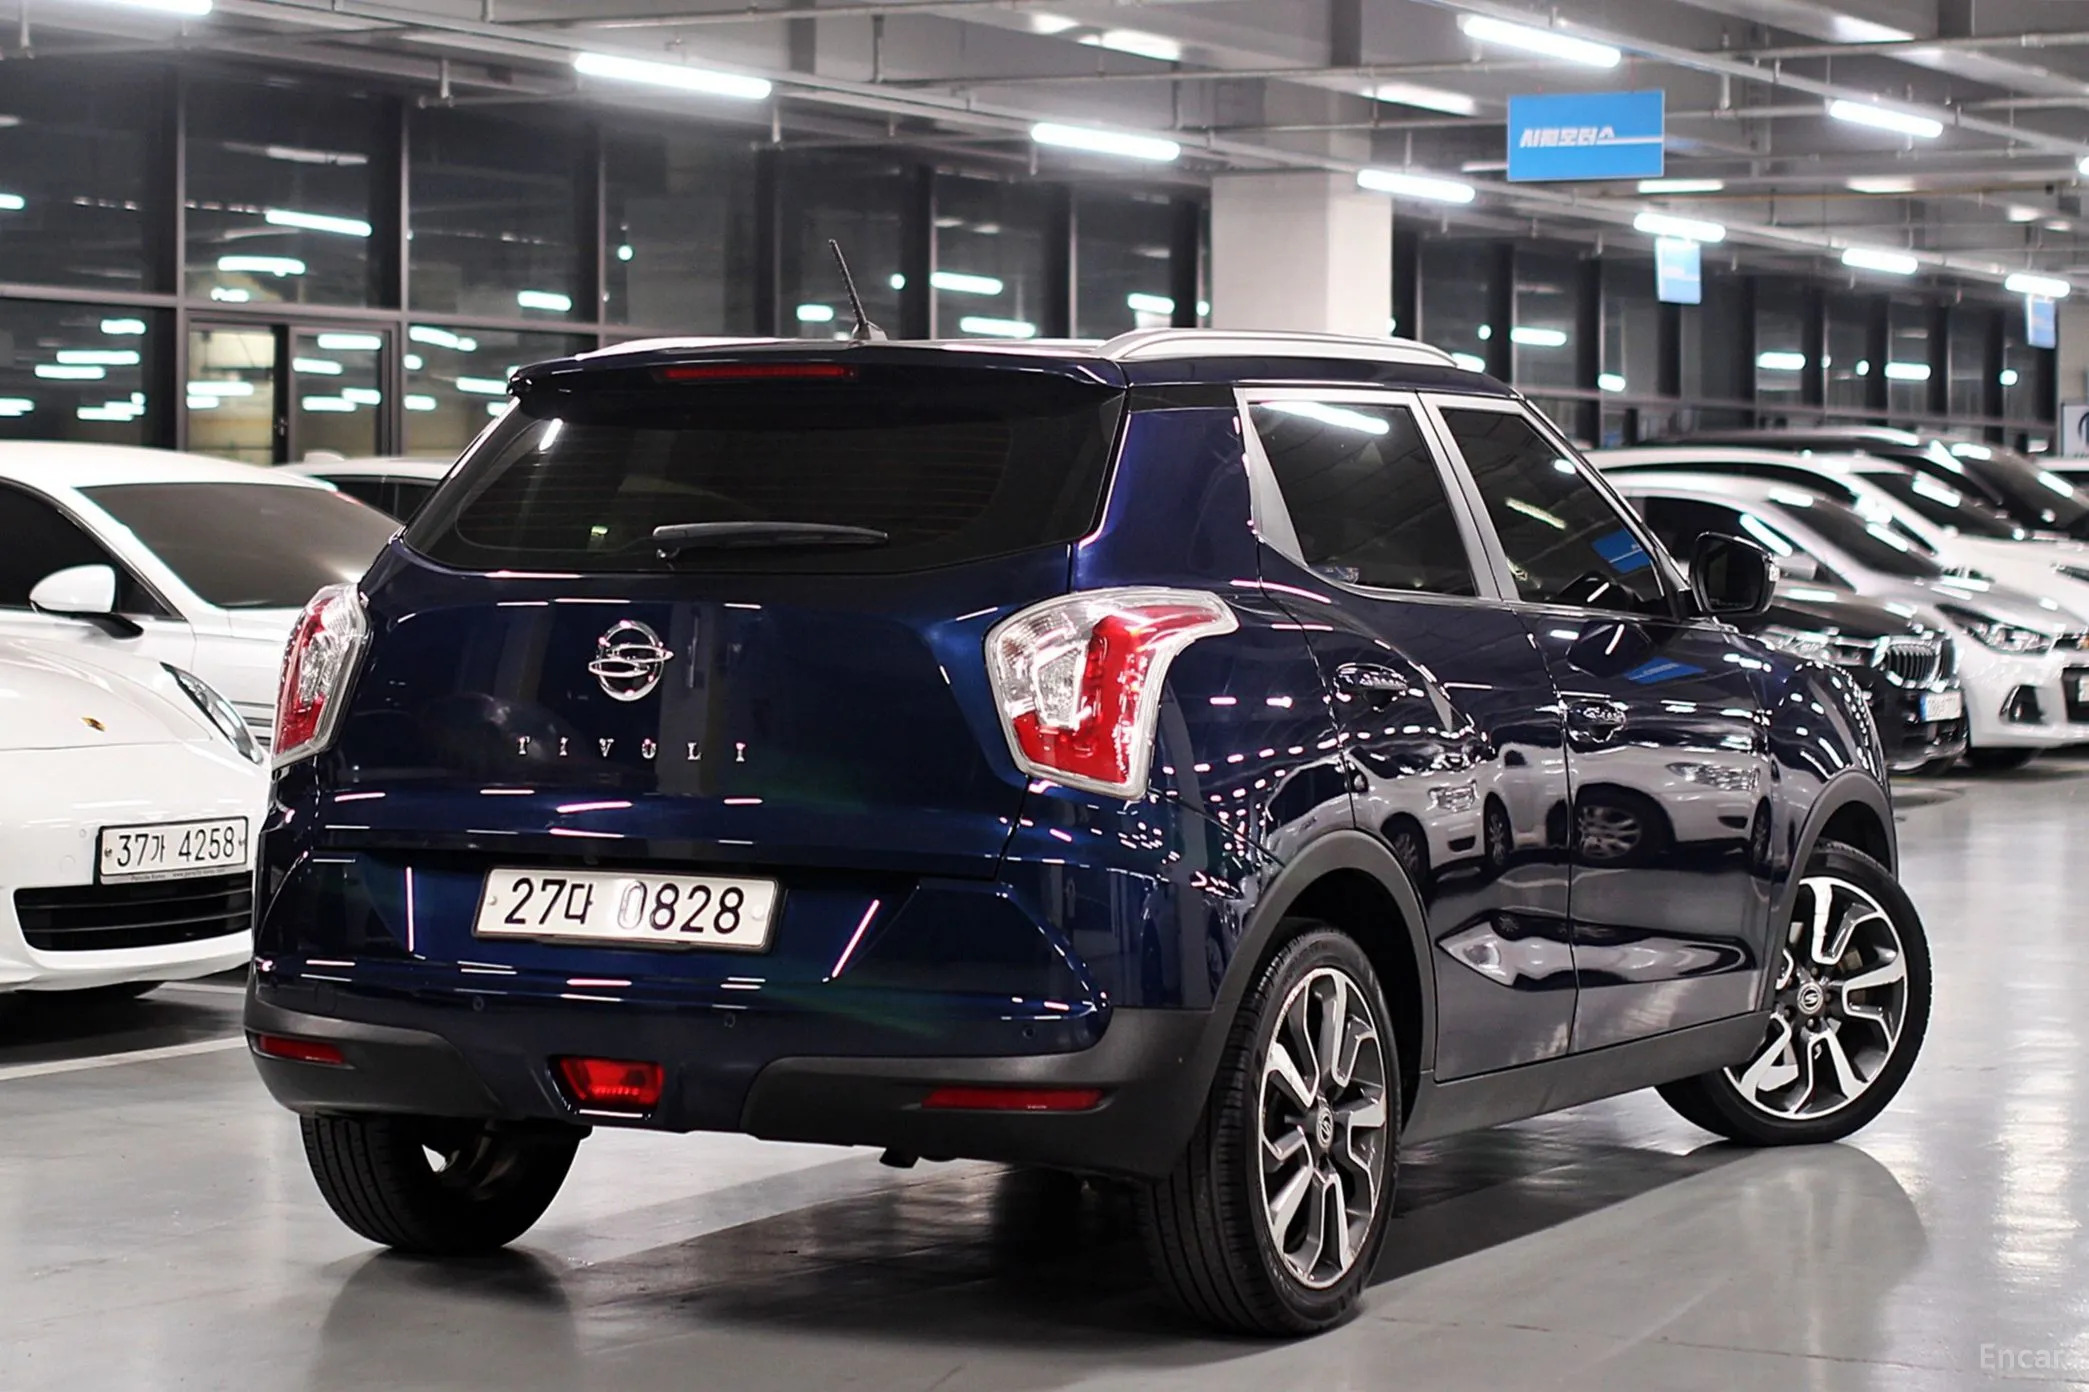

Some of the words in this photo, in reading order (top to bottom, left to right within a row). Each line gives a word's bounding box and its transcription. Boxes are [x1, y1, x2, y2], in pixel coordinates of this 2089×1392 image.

[517, 735, 746, 763] TIVOLI
[117, 833, 166, 867] 37가
[178, 826, 235, 862] 4258
[503, 877, 593, 925] 27다
[617, 880, 745, 935] 0828
